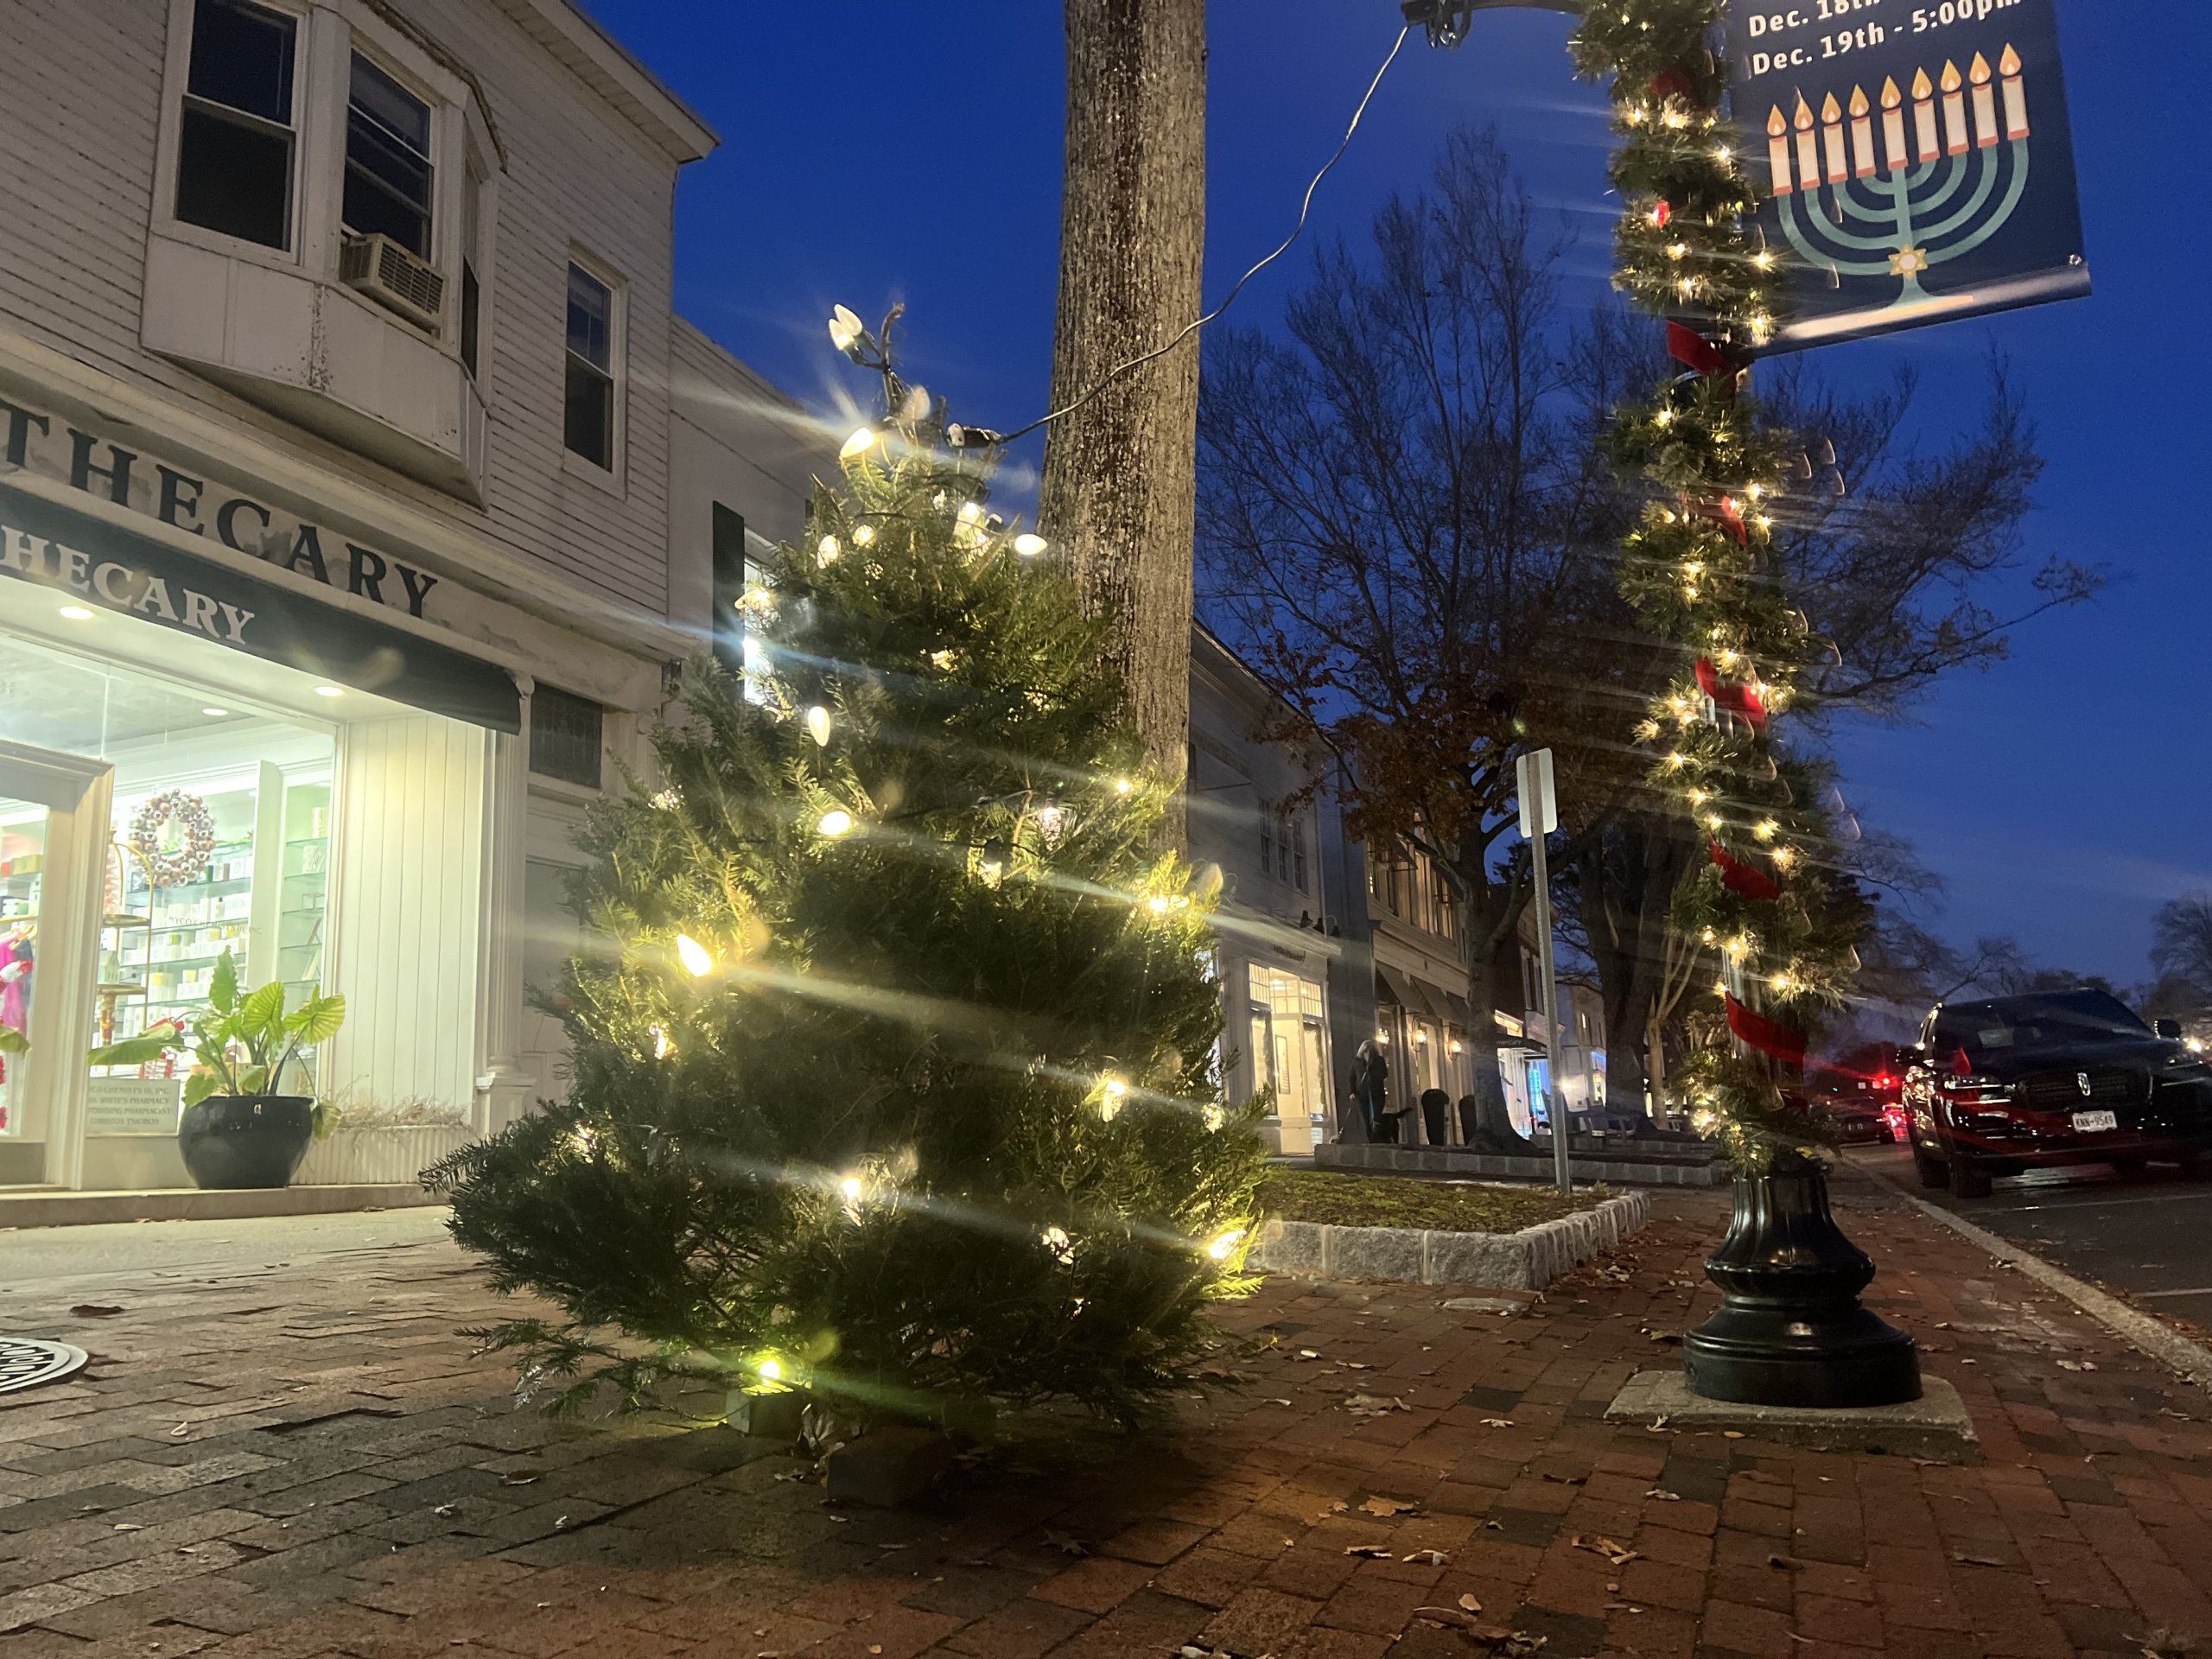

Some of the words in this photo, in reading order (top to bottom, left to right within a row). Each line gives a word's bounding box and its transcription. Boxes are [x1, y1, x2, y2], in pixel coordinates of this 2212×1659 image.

[1749, 10, 1809, 37] Dec.
[1752, 48, 1813, 75] Dec.
[1821, 22, 1885, 59] 19th
[1911, 0, 2022, 33] 5:00p
[0, 524, 255, 645] HECARY
